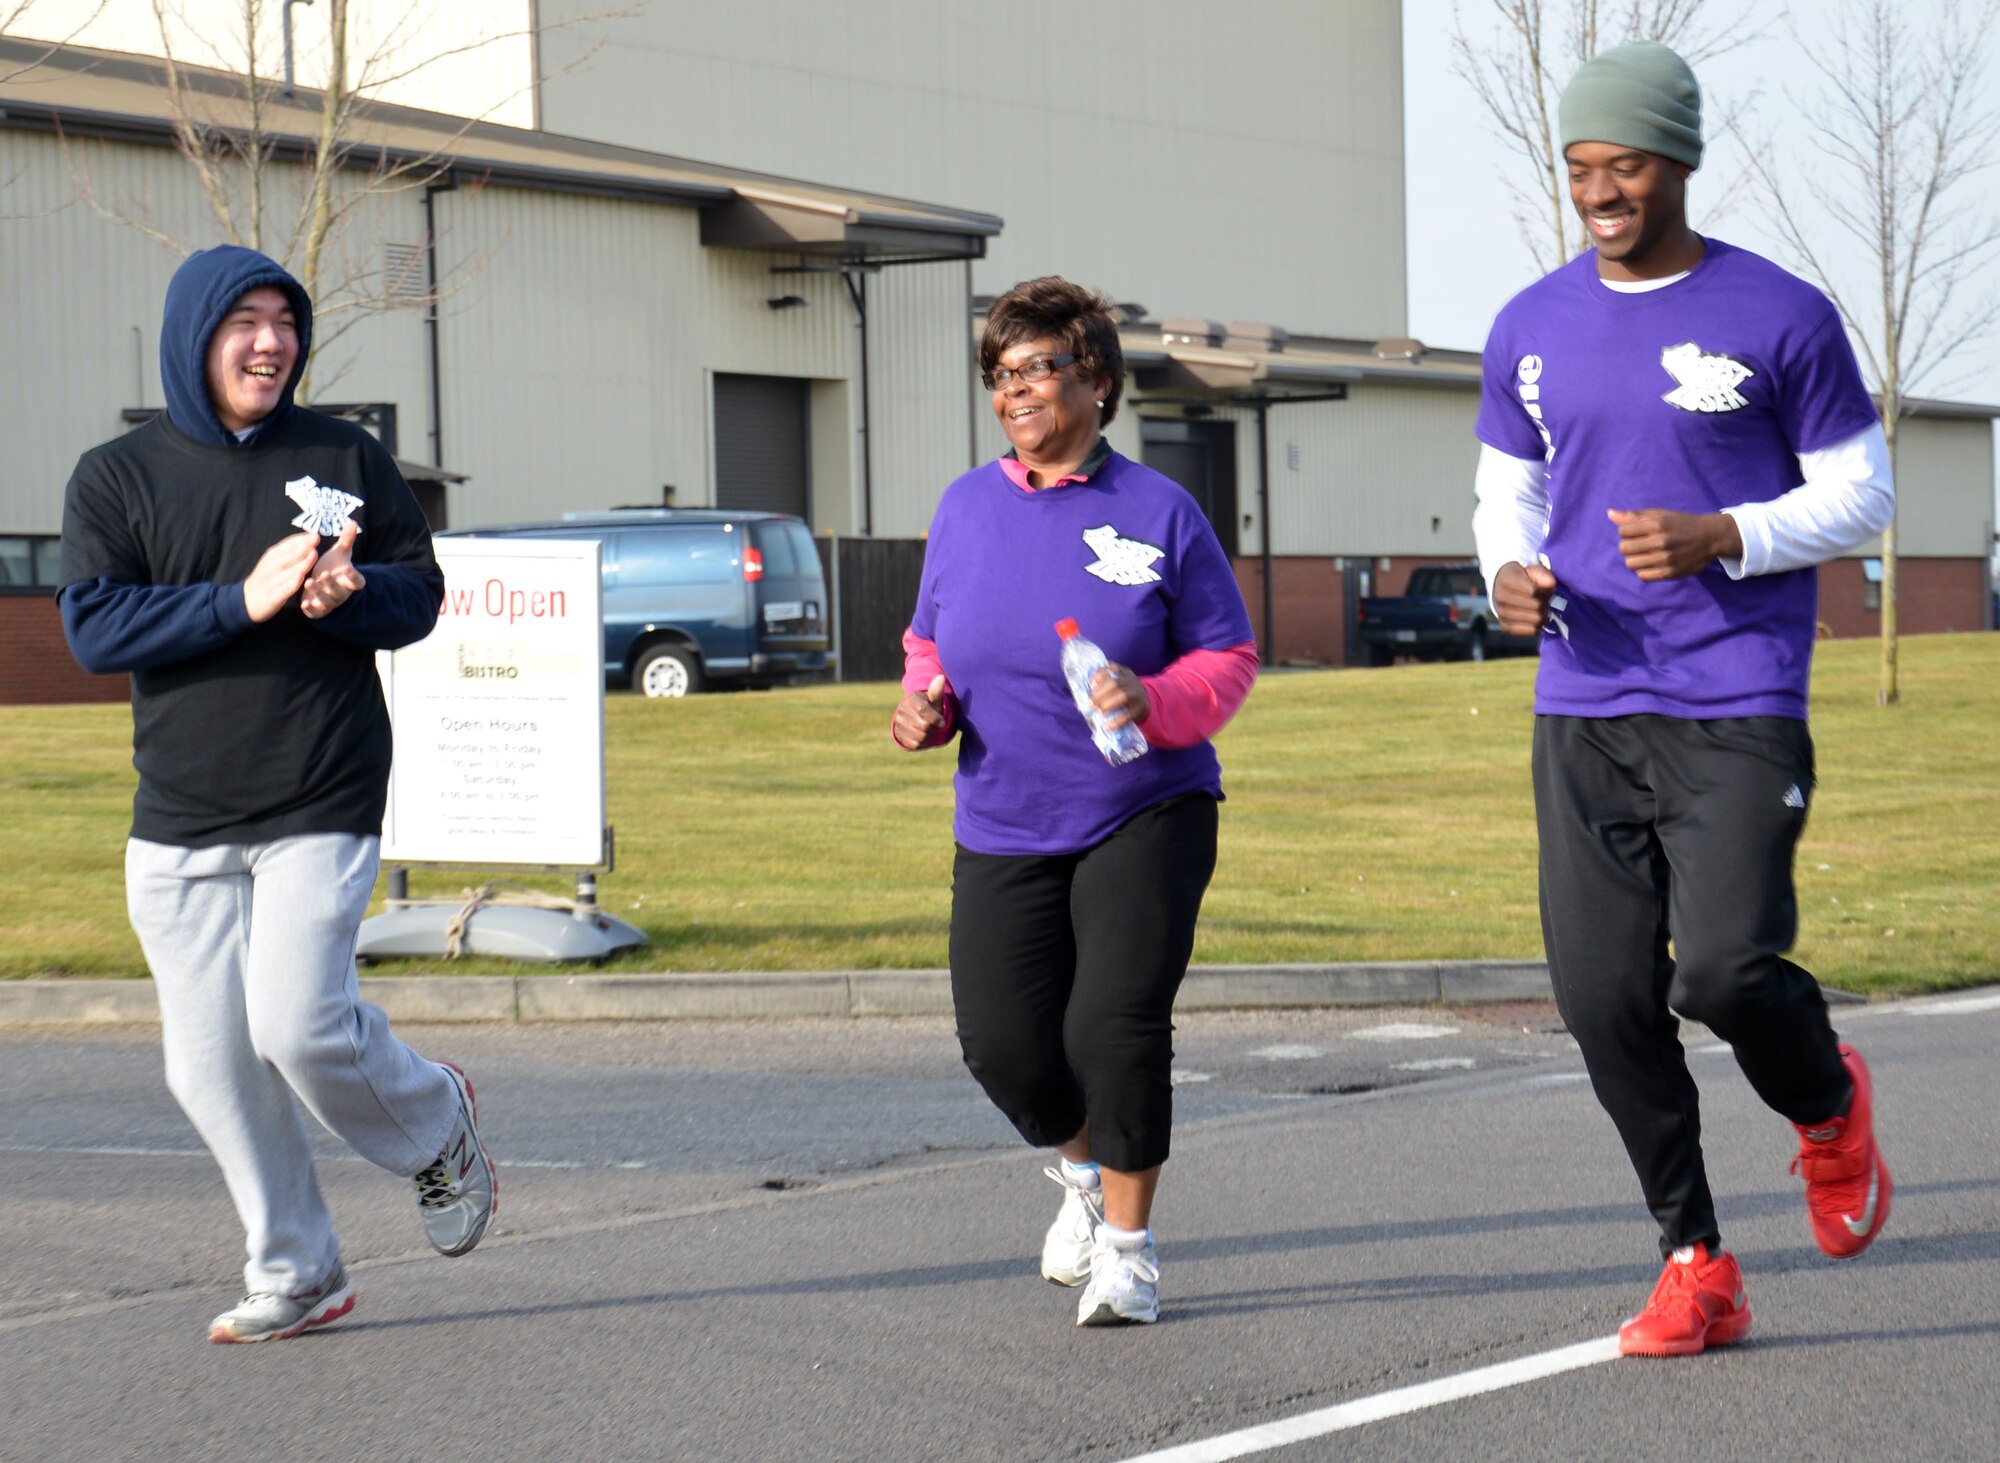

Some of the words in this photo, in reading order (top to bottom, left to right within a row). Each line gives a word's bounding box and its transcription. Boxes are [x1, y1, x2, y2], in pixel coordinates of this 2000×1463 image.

[438, 590, 474, 616] ow
[485, 578, 566, 625] Open
[464, 666, 519, 679] BISTRO
[441, 717, 483, 732] Open
[489, 717, 538, 732] Hours
